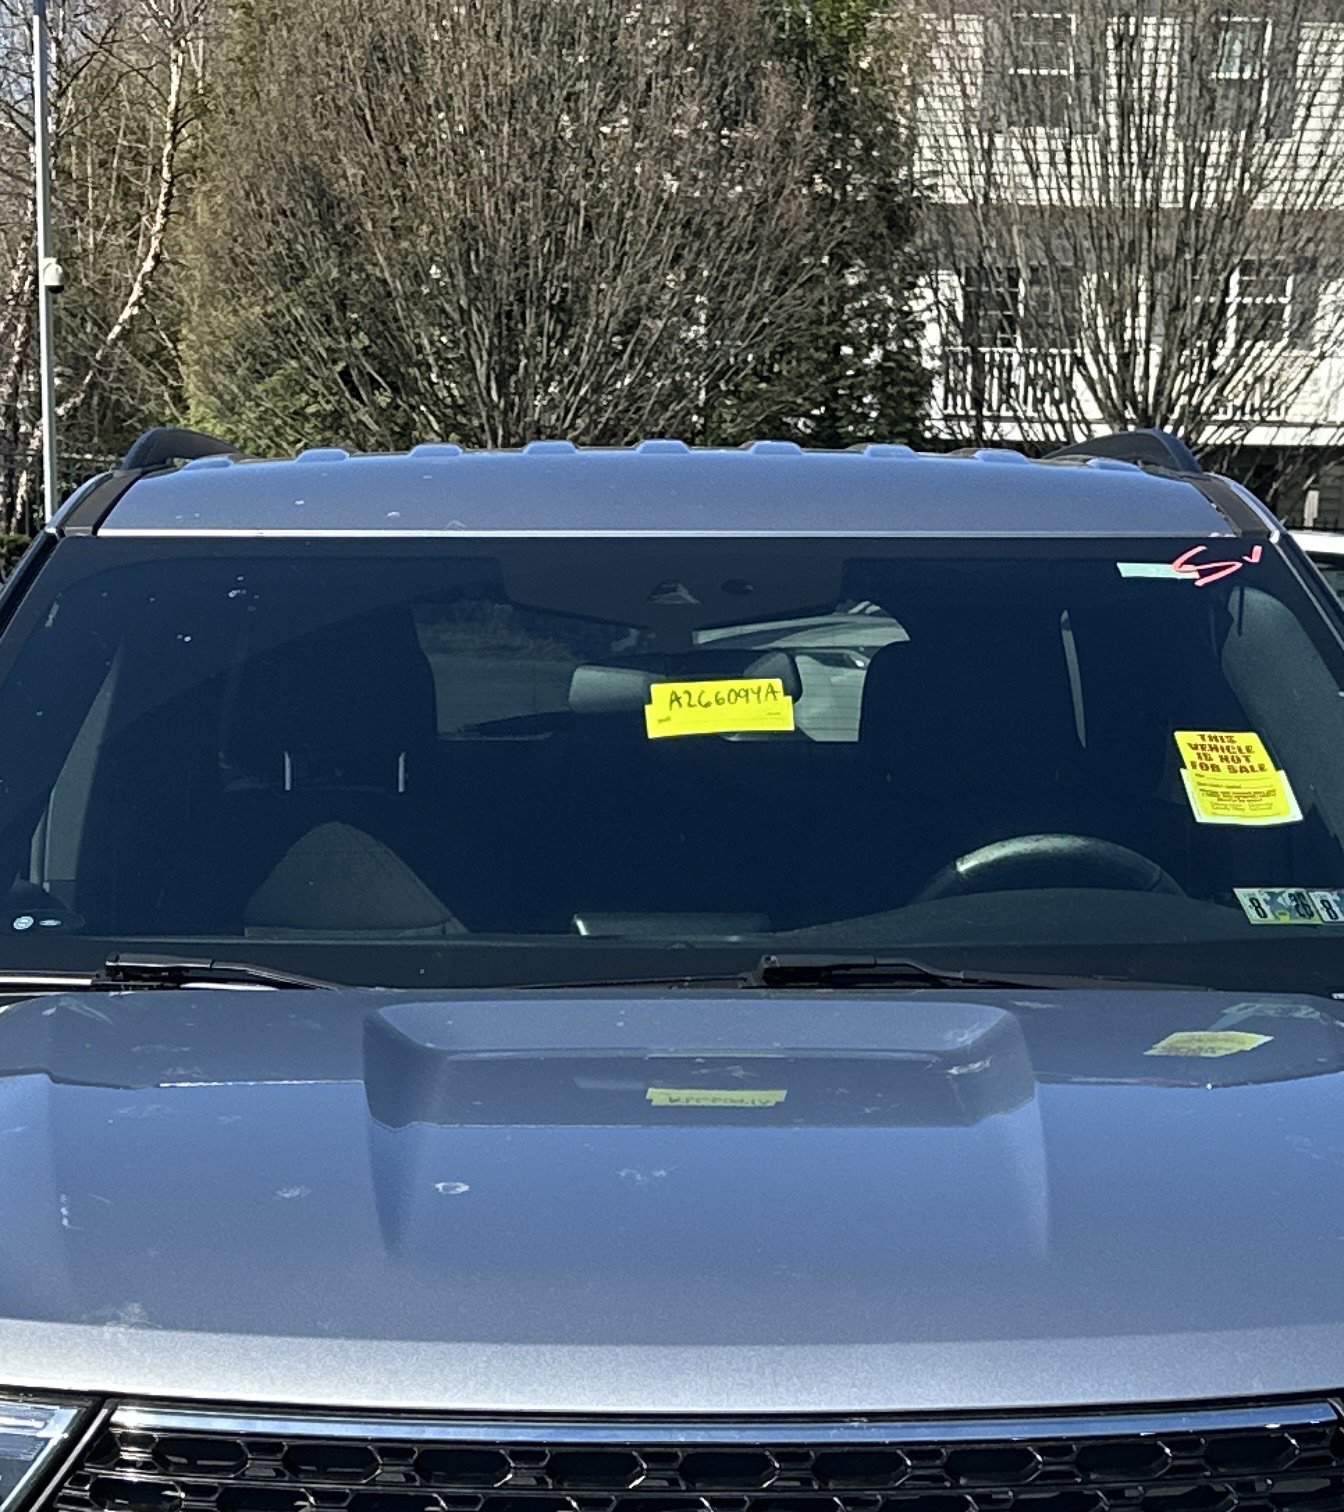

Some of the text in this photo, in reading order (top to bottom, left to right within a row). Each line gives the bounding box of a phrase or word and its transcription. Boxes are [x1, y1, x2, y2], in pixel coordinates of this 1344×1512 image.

[1197, 733, 1238, 744] THIS
[1186, 742, 1256, 755] VEHICLE
[1196, 752, 1252, 764] IS NOT
[1189, 760, 1268, 774] FOR SALE
[1248, 897, 1268, 919] 8
[1320, 899, 1339, 920] 8
